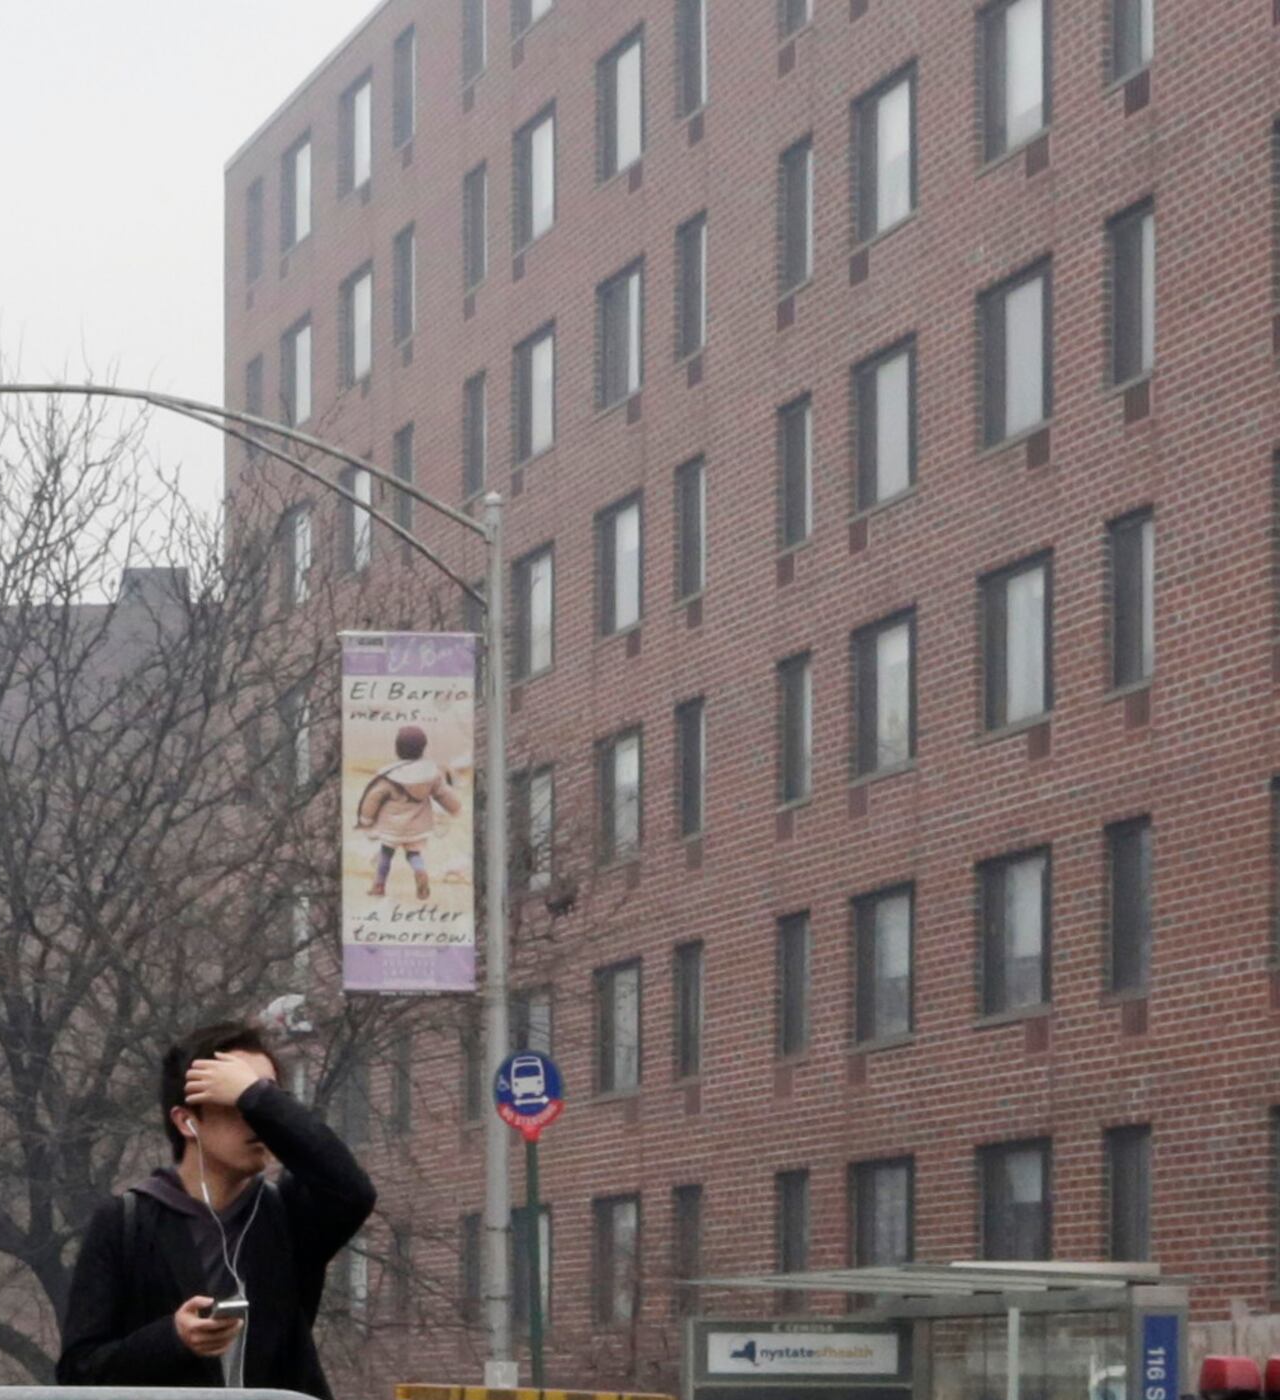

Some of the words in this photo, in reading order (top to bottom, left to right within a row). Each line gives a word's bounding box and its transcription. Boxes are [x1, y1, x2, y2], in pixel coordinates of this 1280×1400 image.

[349, 681, 377, 700] El
[387, 681, 469, 701] Barrio
[390, 904, 463, 922] better
[352, 924, 473, 943] tomorrow.
[1146, 1346, 1166, 1381] 116
